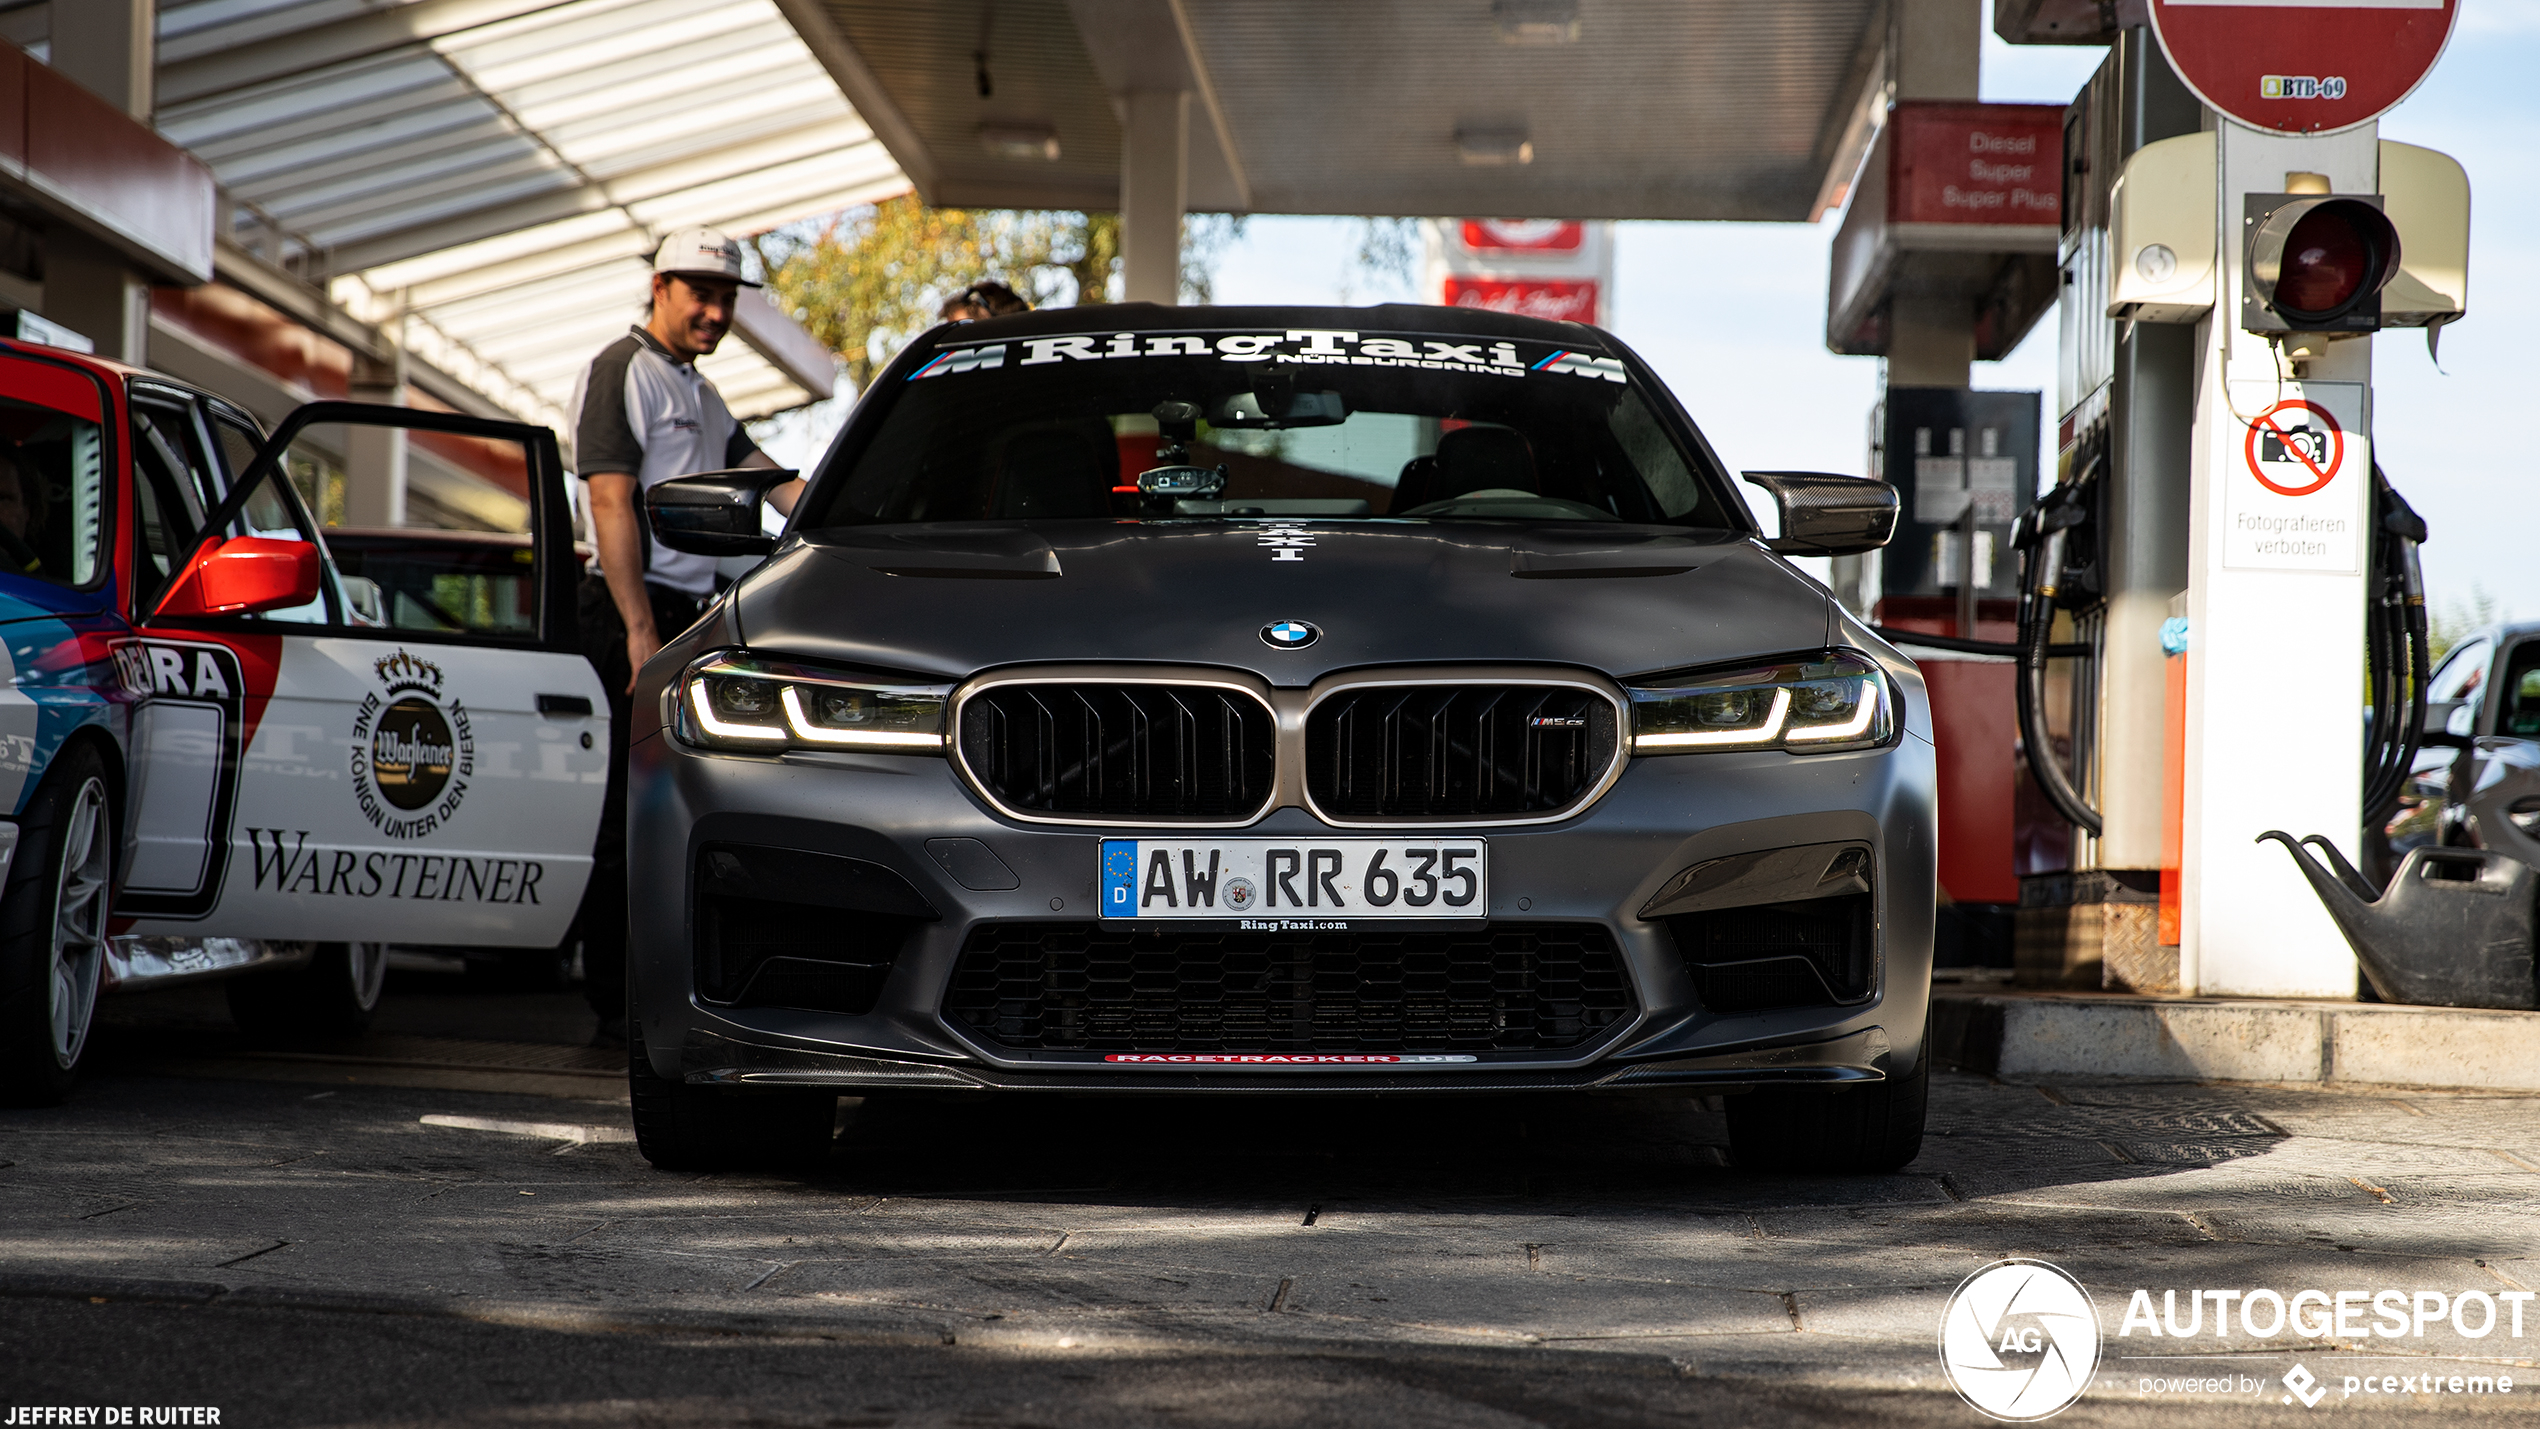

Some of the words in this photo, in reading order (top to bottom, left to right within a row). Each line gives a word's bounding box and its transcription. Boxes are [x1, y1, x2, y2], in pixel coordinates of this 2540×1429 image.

[2282, 79, 2345, 97] BTB-69
[1970, 131, 2036, 154] Diesel
[1970, 159, 2033, 184] Super
[1943, 185, 2005, 210] Super
[2011, 188, 2058, 210] Plus
[1020, 329, 1526, 369] RingTaxi
[1276, 353, 1526, 378] NÜRBURGRING
[2238, 512, 2345, 534] Fotografieren
[2255, 539, 2326, 555] verboten
[353, 691, 381, 741] EINE
[448, 698, 474, 777] BIEREN
[351, 745, 386, 828] KÖNIGIN
[438, 779, 468, 822] DEN
[384, 814, 438, 840] UNTER
[245, 827, 544, 905] WARSTEINER
[1114, 886, 1127, 904] D
[1141, 848, 1221, 907] AW
[1266, 848, 1346, 907] RR
[1364, 848, 1478, 907] 635
